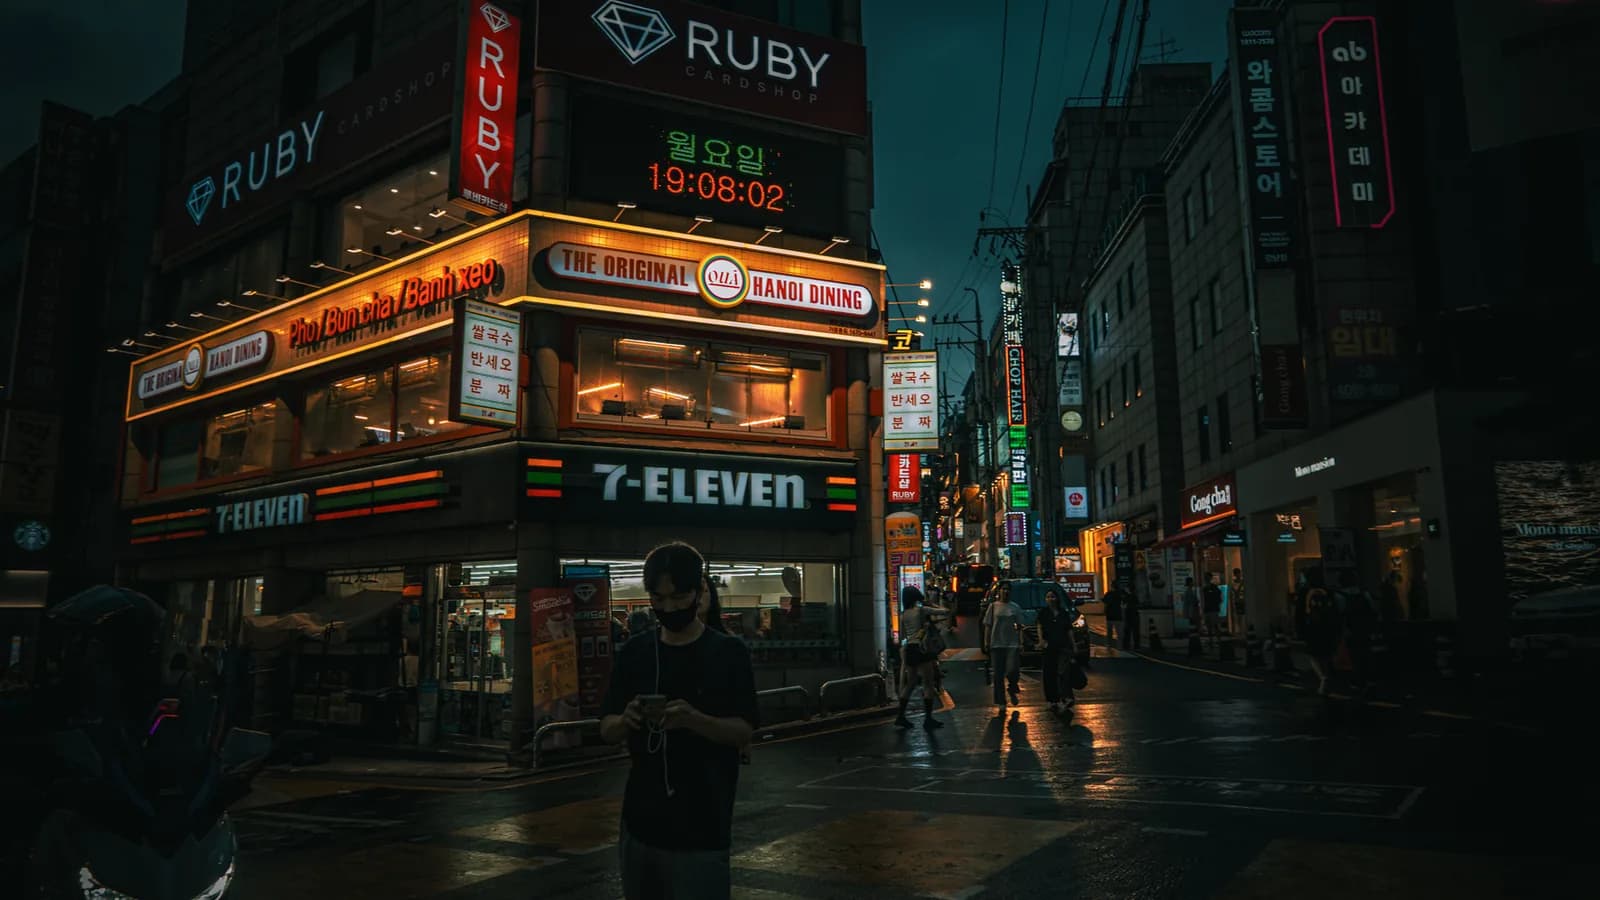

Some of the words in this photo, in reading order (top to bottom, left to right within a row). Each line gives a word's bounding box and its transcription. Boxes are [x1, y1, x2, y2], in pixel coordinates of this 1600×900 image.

[686, 18, 831, 88] RUBY
[337, 61, 451, 135] CARDSHOP
[685, 65, 819, 104] CARDSHOP
[475, 36, 505, 189] RUBY
[1247, 58, 1282, 198] 와콤스토어
[665, 128, 765, 176] 월요일
[1340, 75, 1375, 202] 아카데미
[221, 110, 325, 209] RUBY
[648, 161, 785, 212] 19:08:02
[457, 258, 496, 293] xeo
[562, 248, 597, 275] THE
[603, 254, 689, 288] ORIGINAL
[753, 276, 804, 304] HANOI
[809, 283, 863, 311] DINING
[234, 337, 262, 363] DINING
[472, 323, 513, 346] 쌀국수
[892, 329, 913, 351] 코
[1330, 325, 1393, 357] 임대
[471, 351, 512, 372] 반세오
[891, 371, 931, 385] 쌀국수
[1009, 349, 1021, 385] CHOP
[891, 393, 931, 407] 반세오
[1294, 466, 1311, 478] Mono
[1310, 457, 1335, 473] mansion
[593, 463, 806, 509] 7-ELEVEn
[892, 491, 916, 499] RUBY
[1190, 493, 1211, 514] Gong
[1211, 485, 1226, 506] cha
[215, 493, 308, 534] 7-ELEVEn
[1515, 523, 1556, 536] Mono
